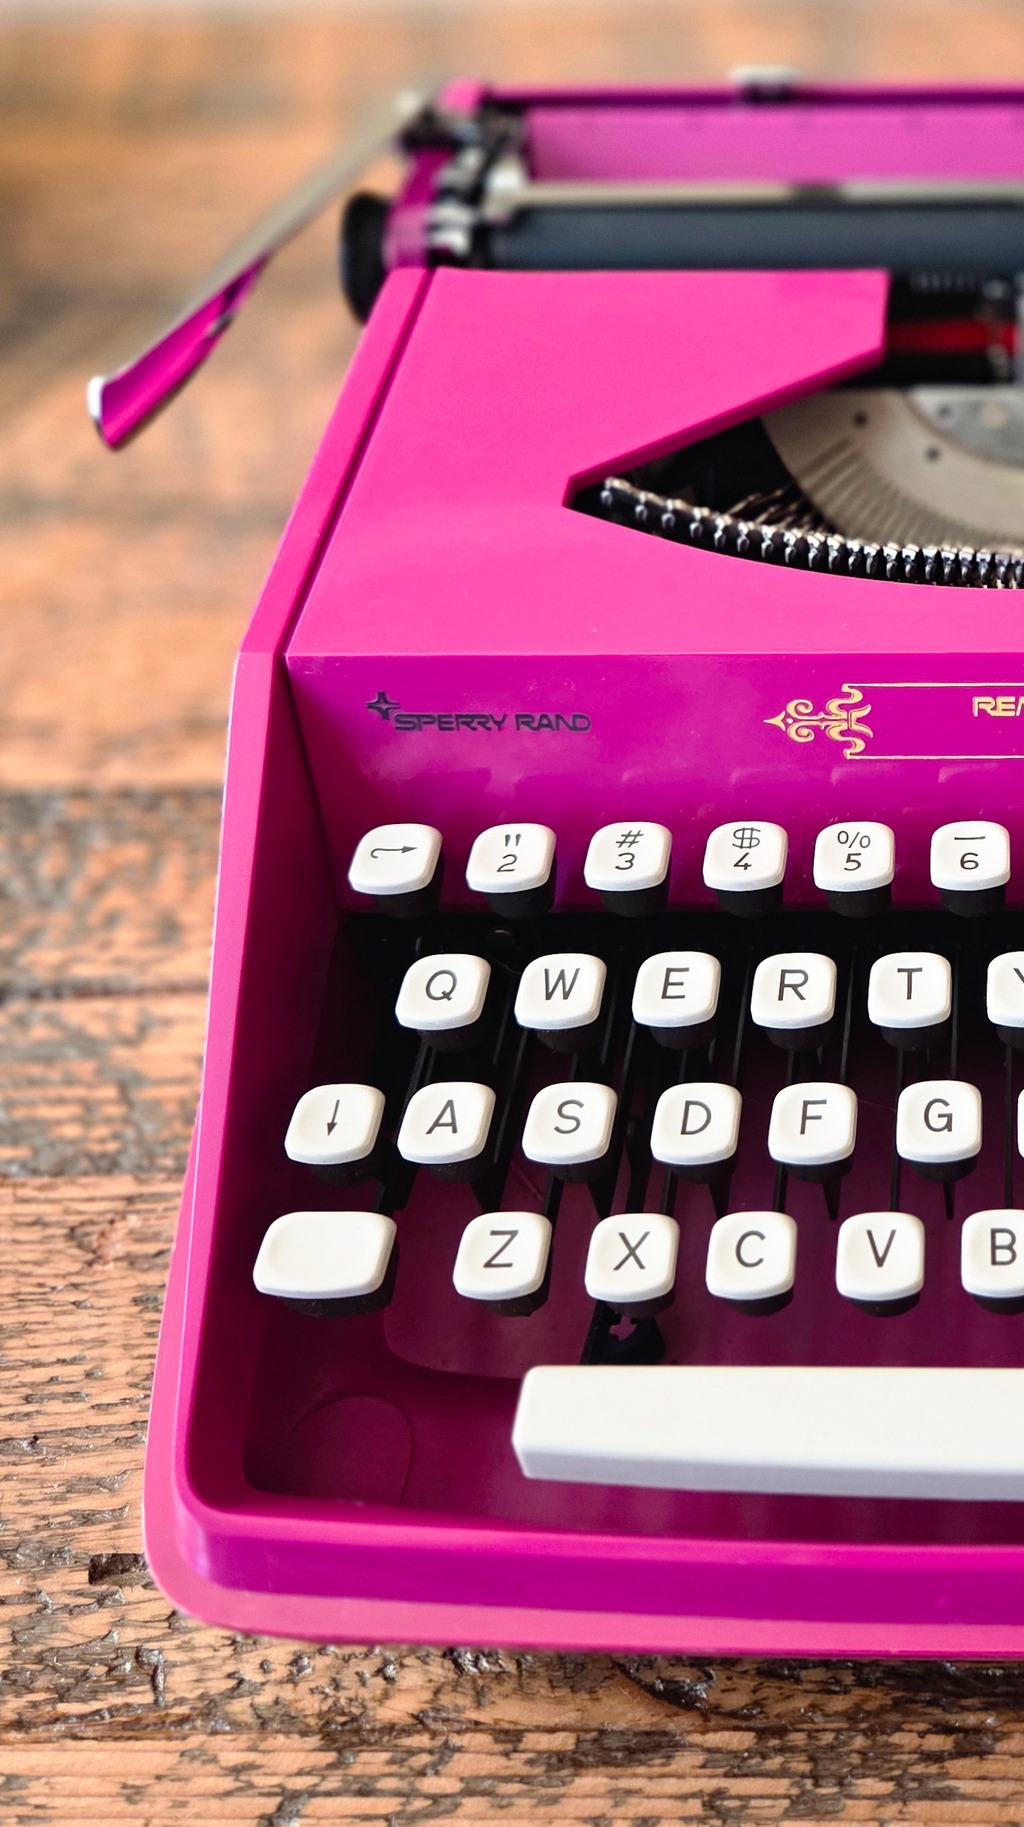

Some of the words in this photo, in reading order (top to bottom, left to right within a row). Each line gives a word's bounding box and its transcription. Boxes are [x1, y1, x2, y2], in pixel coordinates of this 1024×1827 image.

[394, 713, 507, 732] SPERRY
[515, 713, 591, 732] RAND
[614, 829, 645, 850] #
[731, 826, 762, 851] $
[496, 853, 518, 873] 2
[614, 852, 636, 871] 3
[733, 852, 752, 871] 4
[843, 852, 862, 872] 5
[959, 852, 979, 871] 6
[425, 969, 457, 1002] Q
[544, 968, 580, 1001] W
[661, 967, 690, 1000] E
[777, 968, 809, 1002] R
[897, 967, 923, 1001] T
[425, 1099, 458, 1135] A
[553, 1099, 584, 1135] S
[680, 1100, 712, 1136] D
[799, 1099, 827, 1135] F
[923, 1098, 953, 1133] G
[483, 1229, 519, 1269] Z
[613, 1231, 650, 1271] X
[735, 1230, 766, 1268] C
[866, 1229, 896, 1268] V
[990, 1227, 1017, 1266] B
